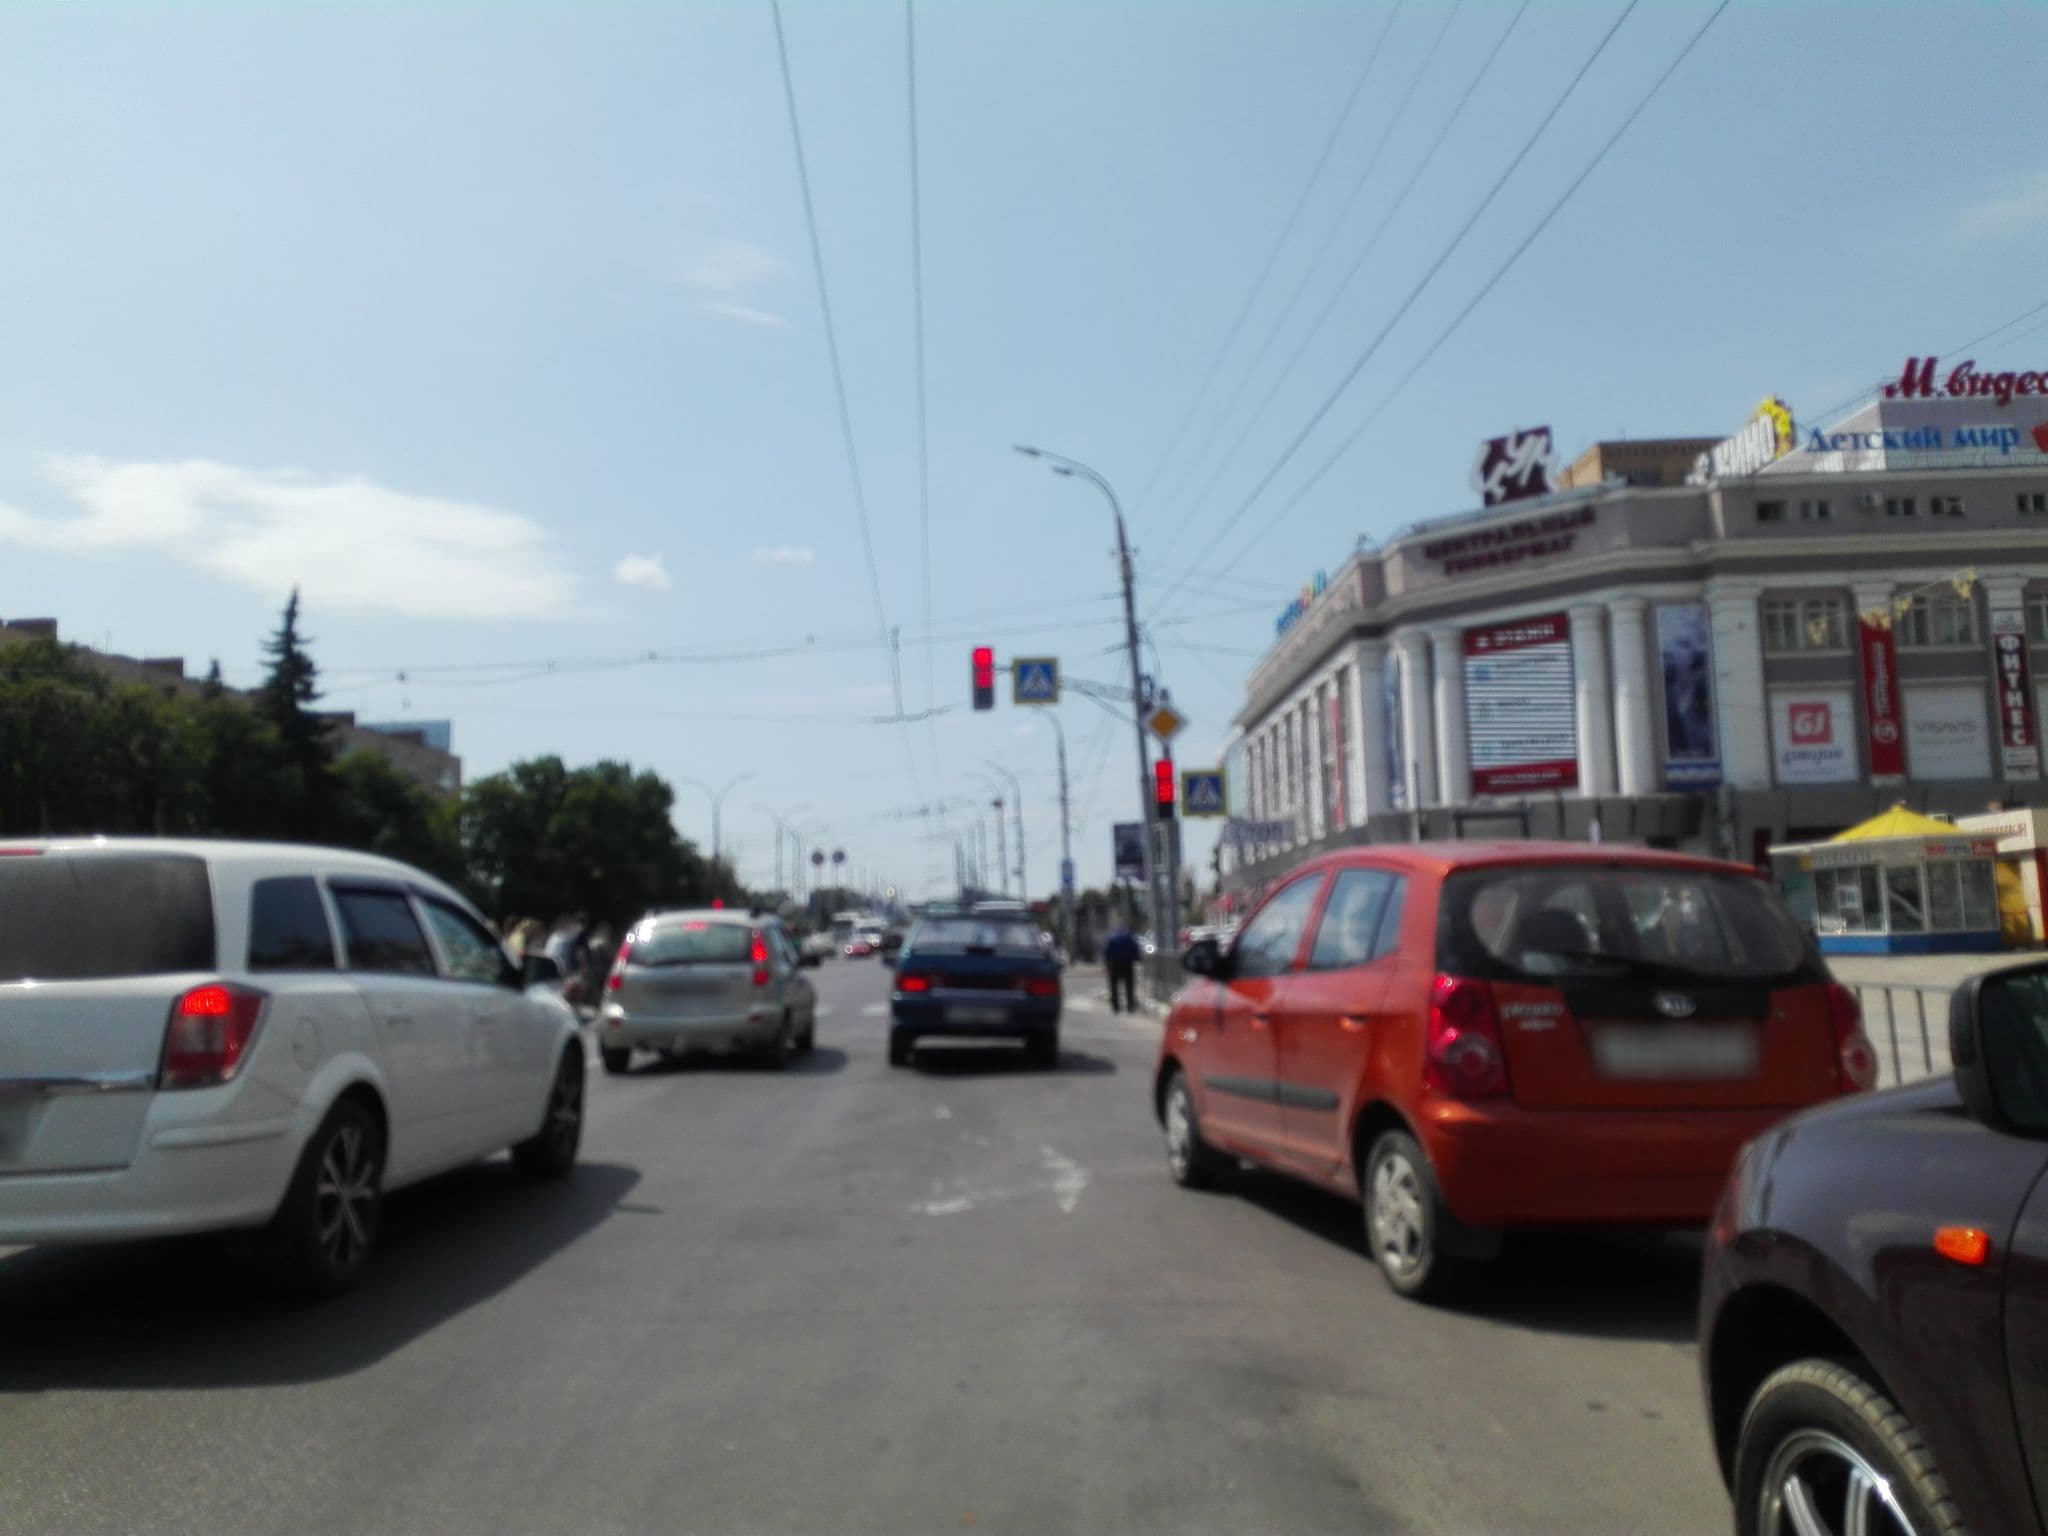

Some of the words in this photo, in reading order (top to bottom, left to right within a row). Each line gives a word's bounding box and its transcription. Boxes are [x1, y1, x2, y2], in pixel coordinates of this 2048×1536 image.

[1807, 424, 1941, 451] Детский
[1954, 427, 2019, 455] мир
[1999, 635, 2027, 746] ФИТНЕС
